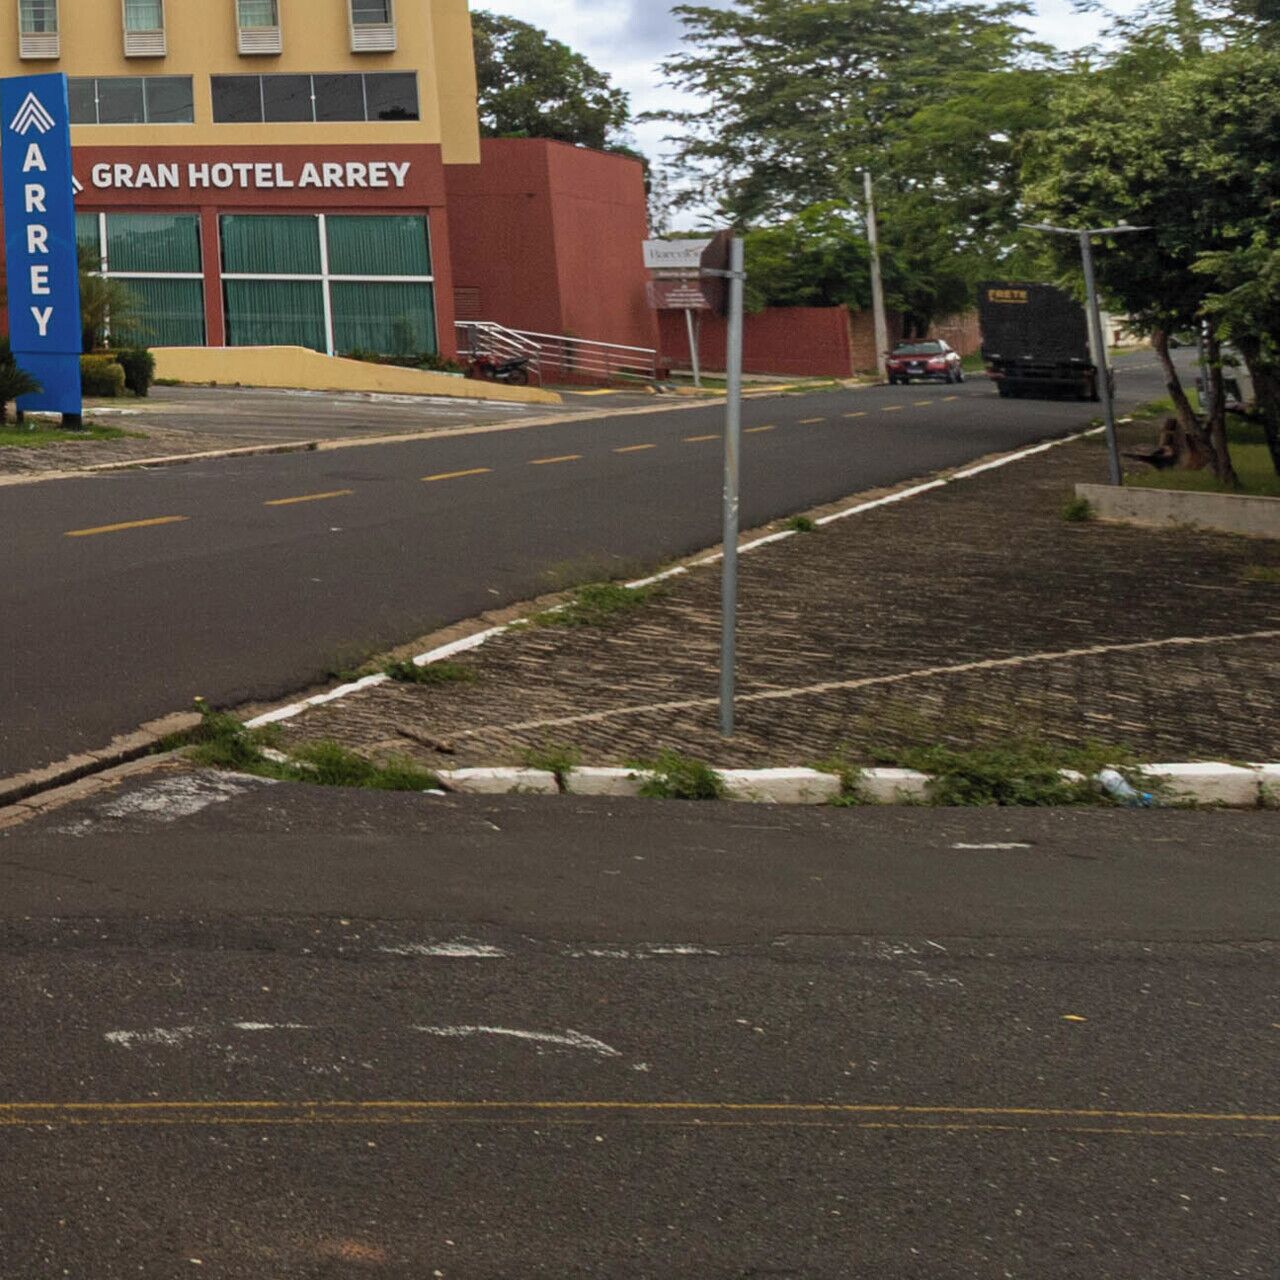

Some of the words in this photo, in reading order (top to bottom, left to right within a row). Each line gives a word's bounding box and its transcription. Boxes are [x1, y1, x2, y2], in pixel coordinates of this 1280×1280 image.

[92, 162, 179, 188] GRAN
[189, 162, 293, 188] HOTEL
[298, 161, 411, 188] ARREY
[23, 143, 54, 336] ARREY
